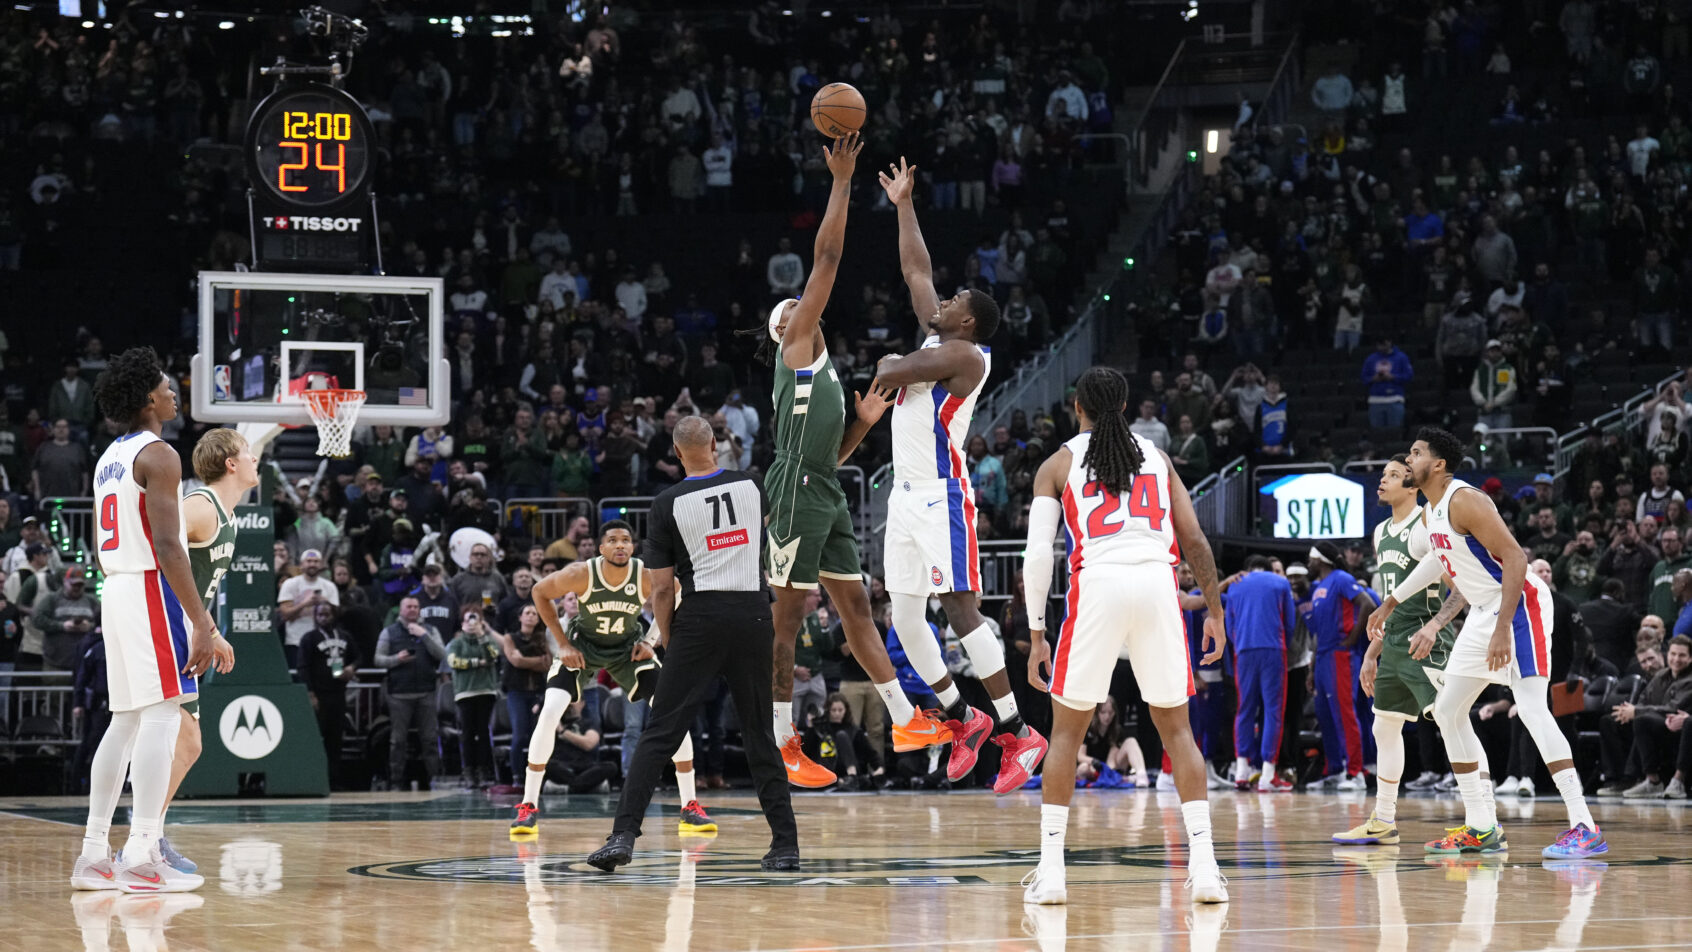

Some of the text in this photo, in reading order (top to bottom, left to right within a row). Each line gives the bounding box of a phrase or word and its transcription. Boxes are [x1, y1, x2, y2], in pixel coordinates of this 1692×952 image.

[283, 111, 351, 140] 12:00
[278, 141, 346, 193] 24
[289, 216, 362, 232] TISSOT
[96, 461, 127, 488] THOMPSON
[704, 491, 737, 530] 71
[1081, 473, 1167, 539] 24
[100, 493, 120, 551] 9
[235, 513, 270, 529] wilo
[1288, 498, 1350, 538] STAY
[710, 534, 745, 547] Emirates
[231, 562, 269, 572] ULTRA
[232, 610, 259, 621] BUCKS
[585, 600, 640, 615] MILWAUKEE
[595, 616, 625, 635] 34
